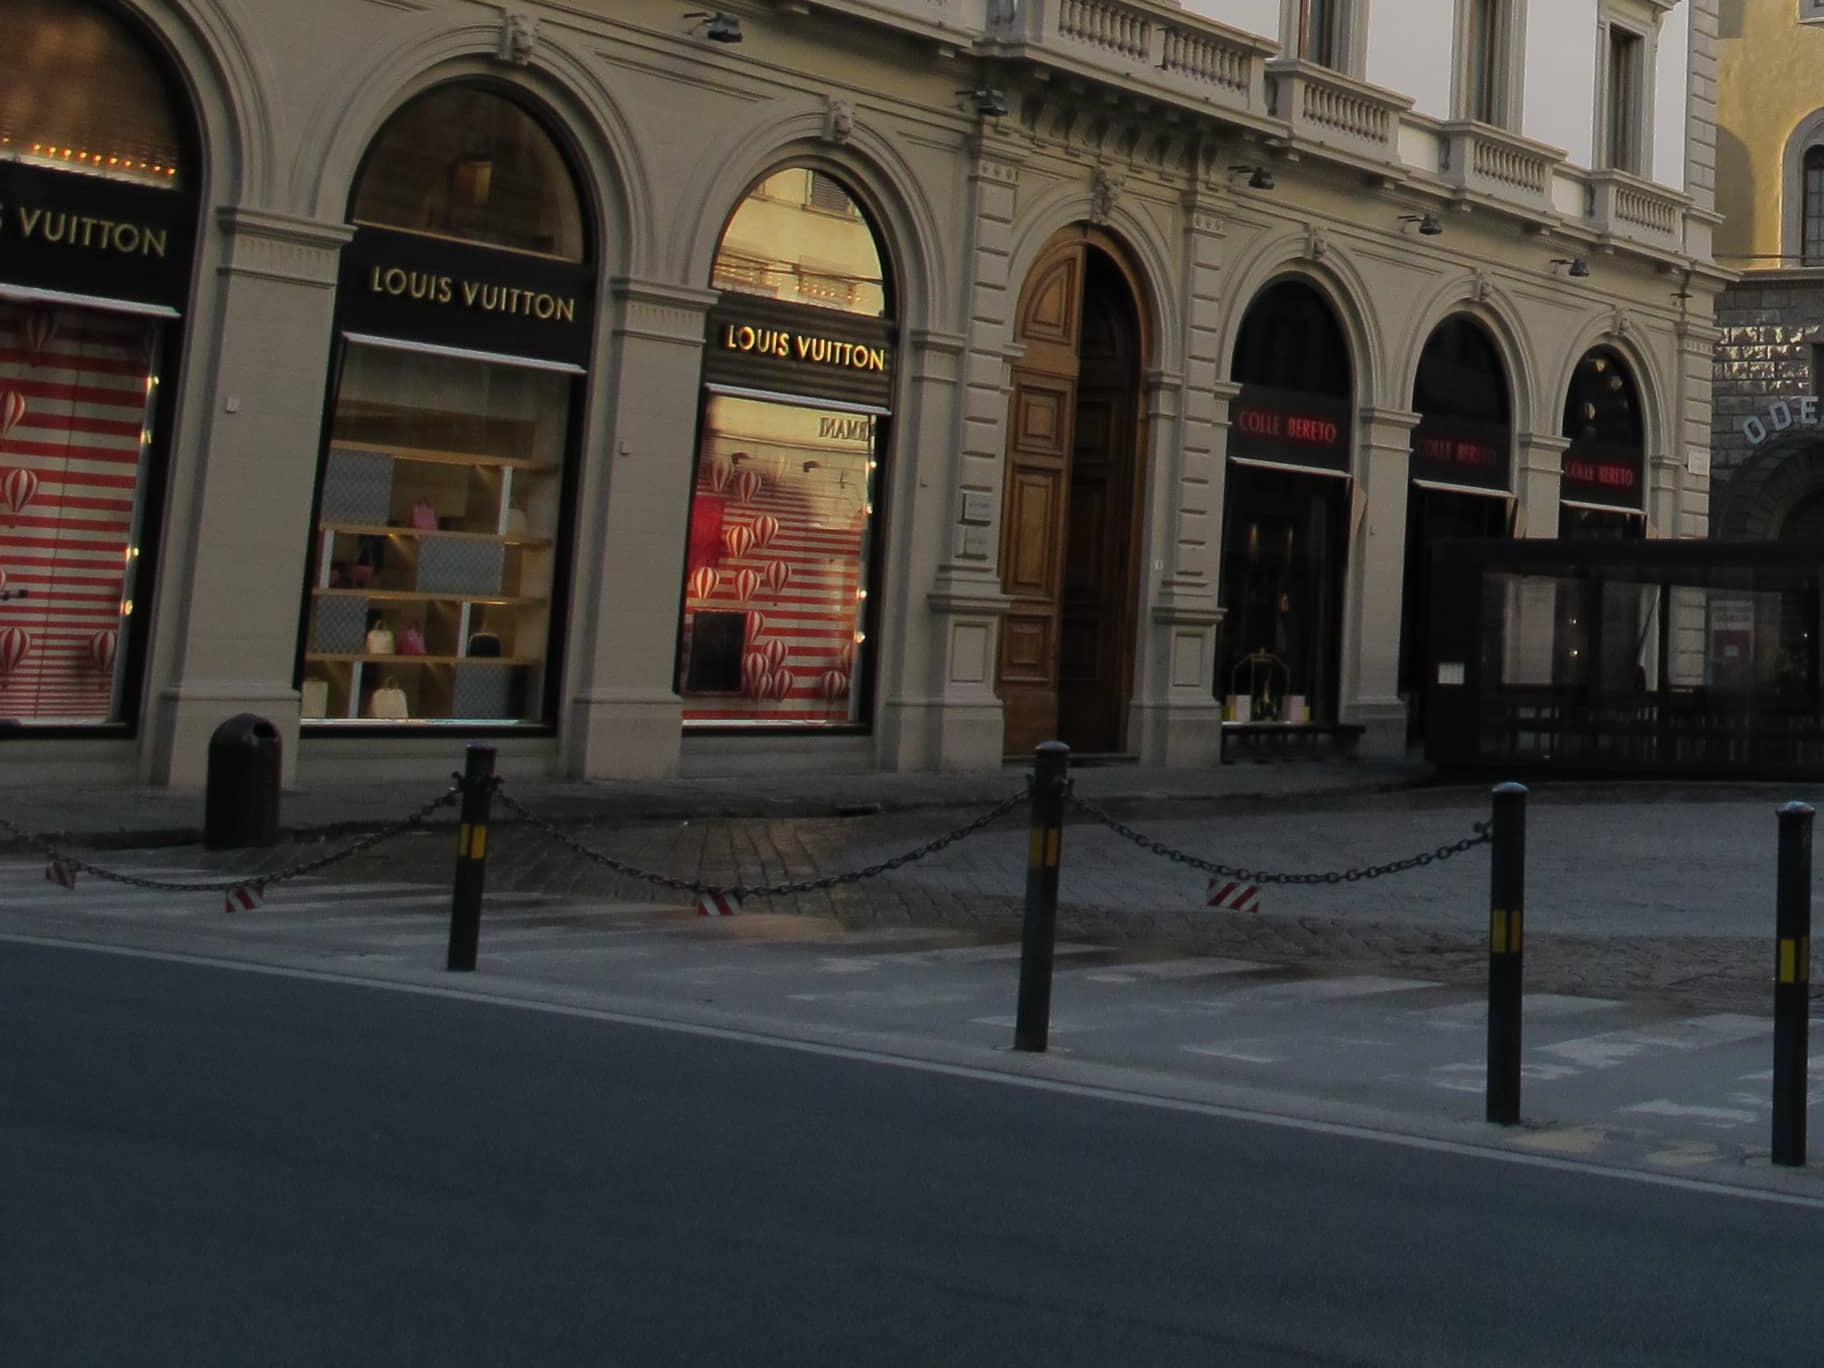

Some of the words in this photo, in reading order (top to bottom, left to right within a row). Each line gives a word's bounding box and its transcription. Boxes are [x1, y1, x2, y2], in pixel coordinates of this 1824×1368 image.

[19, 207, 168, 258] VUITTON
[372, 265, 452, 303] LOUIS
[463, 280, 575, 322] VUITTON
[727, 324, 790, 357] LOUIS
[797, 335, 885, 372] VUITTON
[1238, 410, 1280, 435] COLLE
[1287, 416, 1337, 443] BERETO
